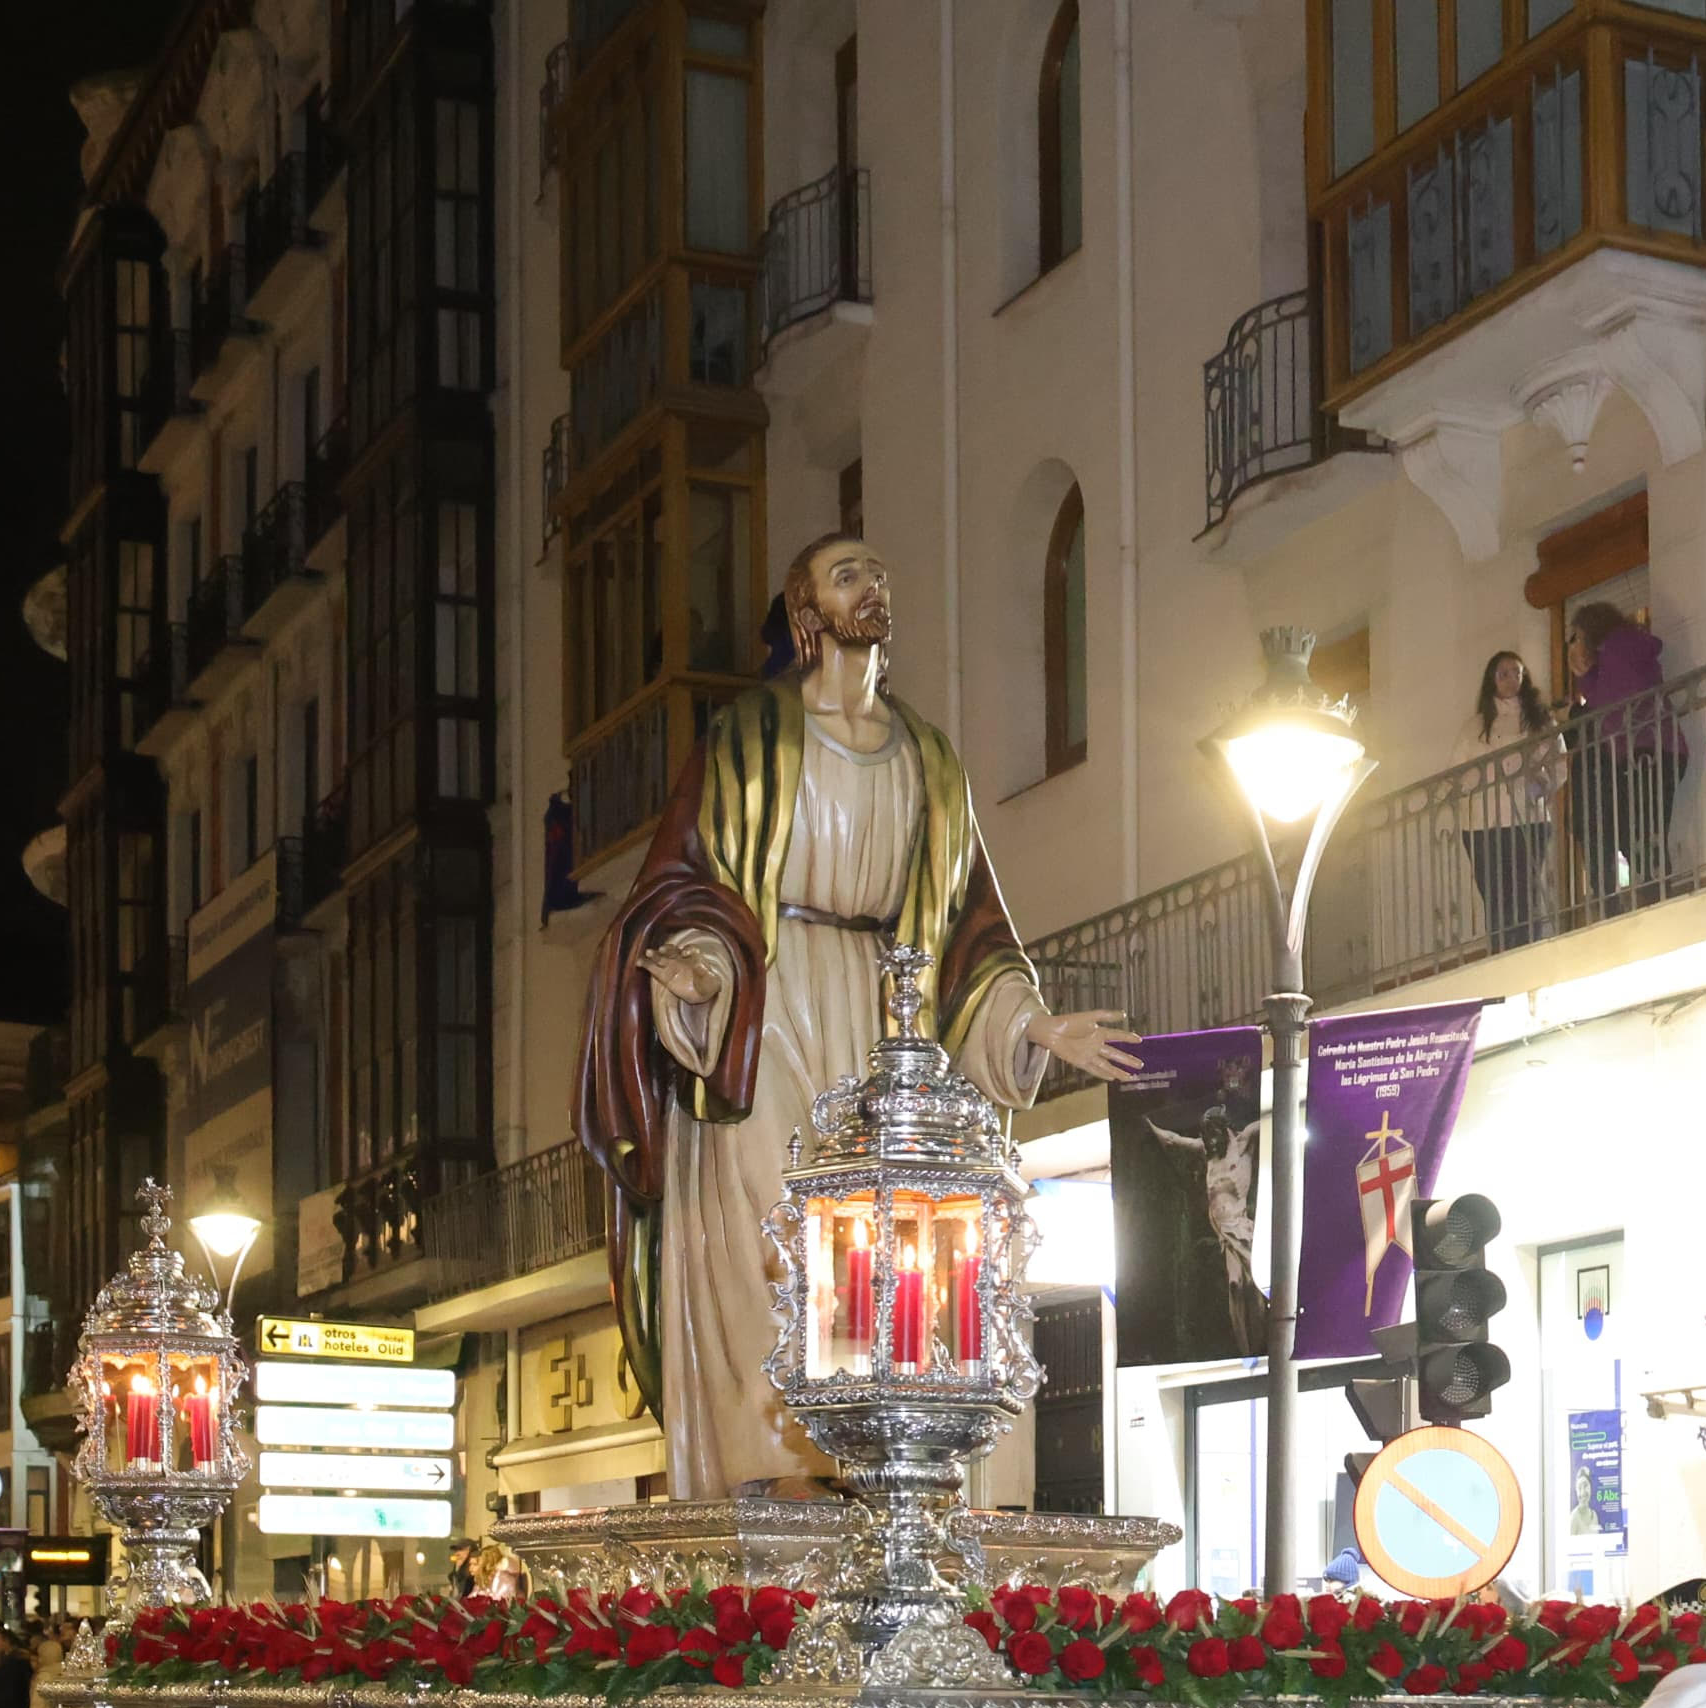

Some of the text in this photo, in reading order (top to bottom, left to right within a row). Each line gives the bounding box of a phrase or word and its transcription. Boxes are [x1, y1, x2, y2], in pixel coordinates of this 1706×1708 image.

[1347, 1042, 1356, 1053] de
[1385, 1037, 1406, 1050] Padre
[1335, 1049, 1449, 1071] María Santísima de la Alegría y
[1341, 1064, 1440, 1087] las Lágrimas de San Pedro
[325, 1328, 356, 1339] otros
[325, 1341, 369, 1352] hoteles
[378, 1344, 403, 1355] Olid
[1596, 1490, 1603, 1502] 6
